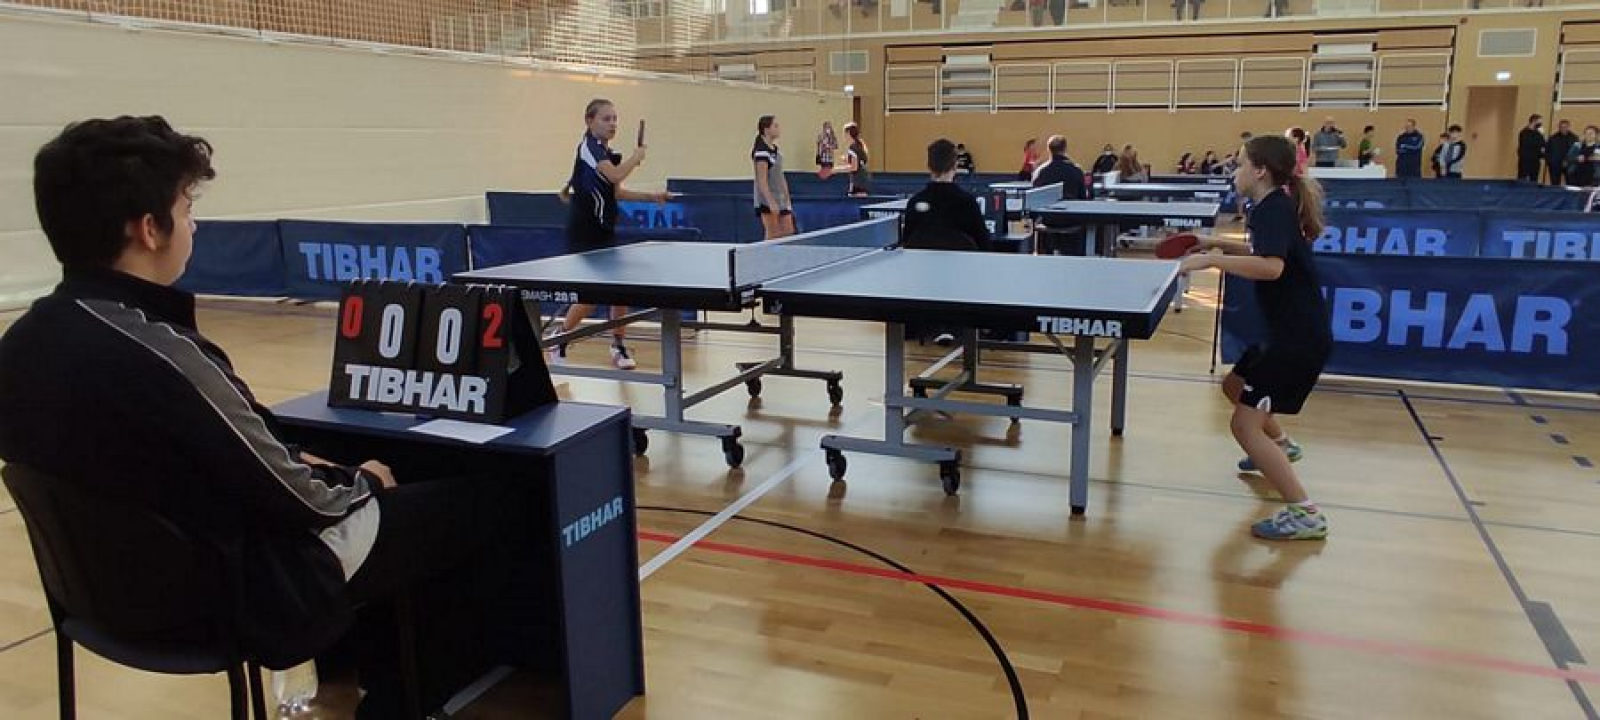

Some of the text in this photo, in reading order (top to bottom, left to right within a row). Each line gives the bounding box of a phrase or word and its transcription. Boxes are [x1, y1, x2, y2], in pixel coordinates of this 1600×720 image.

[298, 241, 443, 285] TIBHAR
[1313, 226, 1447, 257] BHAR
[342, 296, 504, 365] 0 0 0 2
[1036, 316, 1123, 338] TIBHAR
[1321, 286, 1573, 355] BHAR
[345, 363, 488, 415] TIBHAR
[562, 497, 623, 547] TIBHAR
